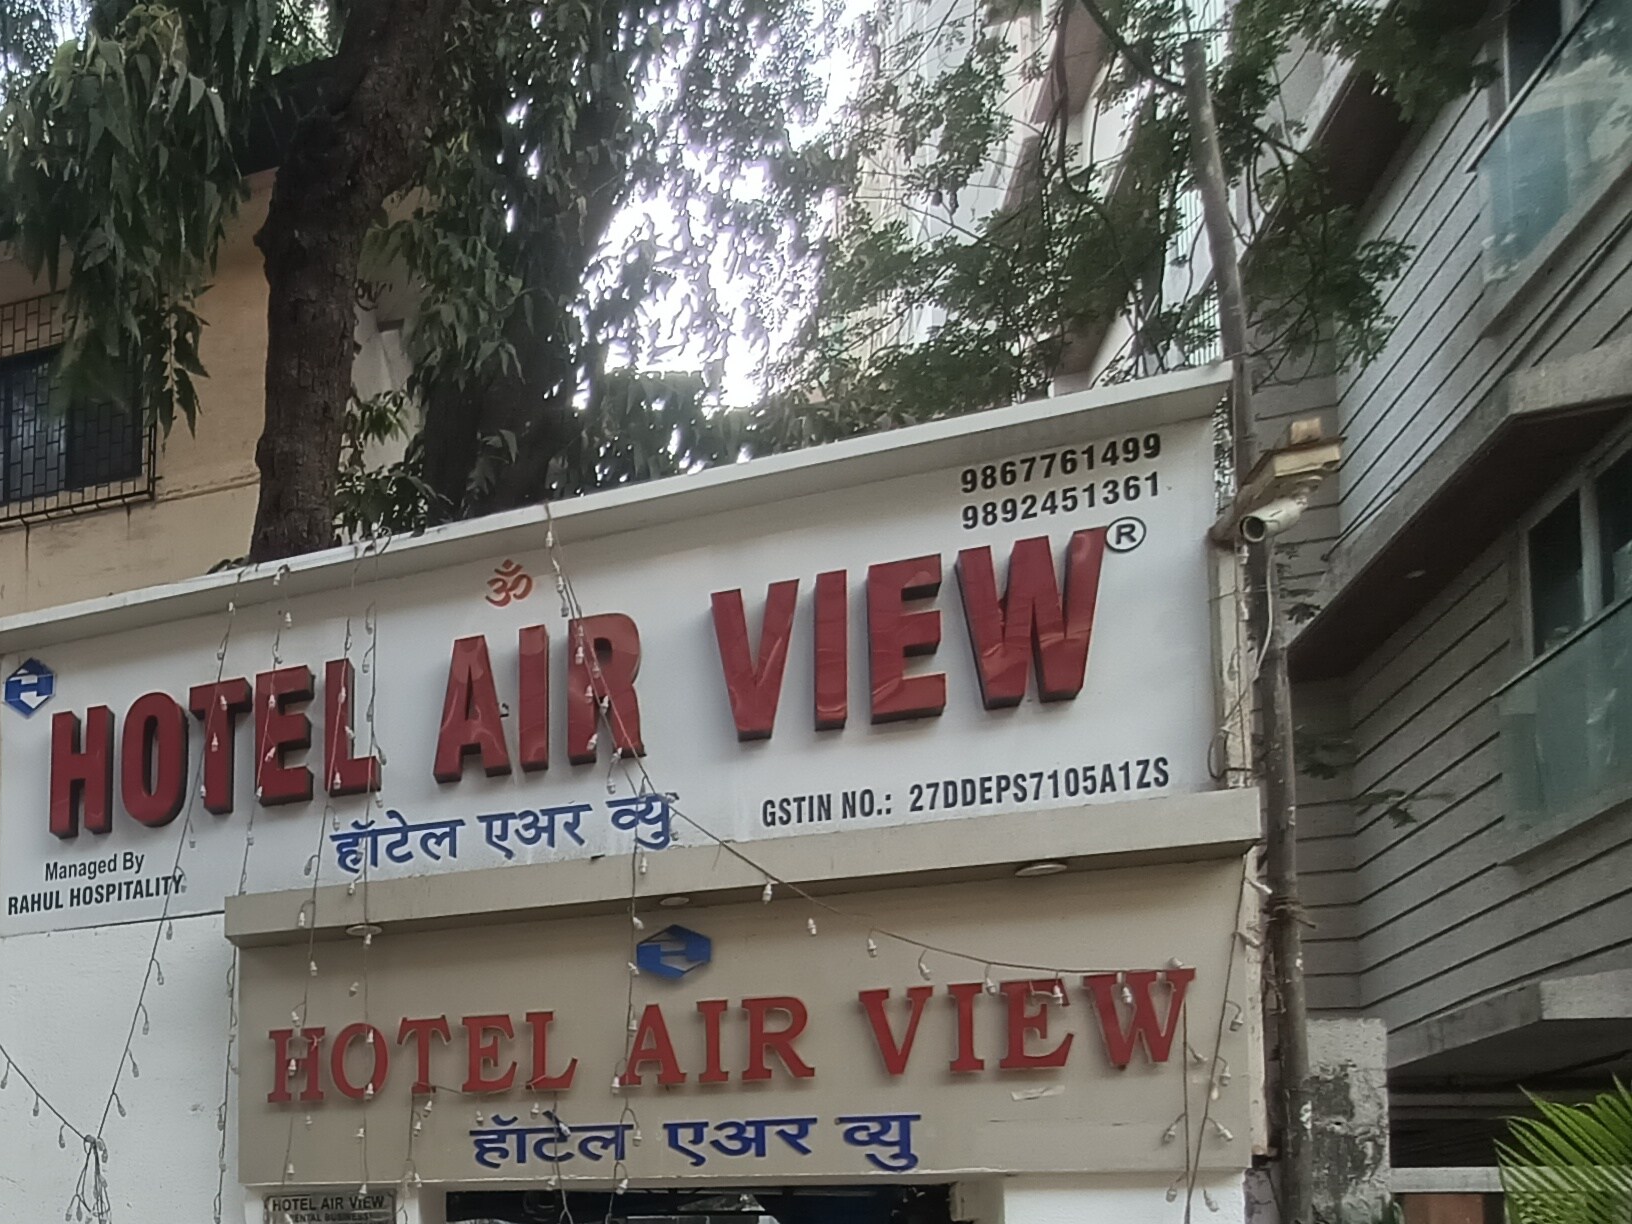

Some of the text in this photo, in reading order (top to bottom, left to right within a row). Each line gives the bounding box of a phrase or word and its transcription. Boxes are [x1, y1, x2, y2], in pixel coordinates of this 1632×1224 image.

[961, 433, 1162, 494] 9867761499
[962, 471, 1159, 530] 9892451361
[49, 658, 382, 839] HOTEL
[433, 612, 647, 783] AIR
[711, 526, 1107, 742] VIEW
[762, 793, 833, 828] GSTIN
[909, 756, 1170, 813] 27DDEPS7105A1ZS
[330, 793, 675, 874] हॉटेल एअर व्यु
[7, 873, 184, 916] RAHUL HOSPITALITY
[44, 851, 146, 882] Managed By
[268, 967, 1197, 1104] HOTEL AIR VIEW
[469, 1109, 922, 1172] हॉटेल एअर व्यु
[272, 1195, 385, 1212] HOTEL AIR VIEW
